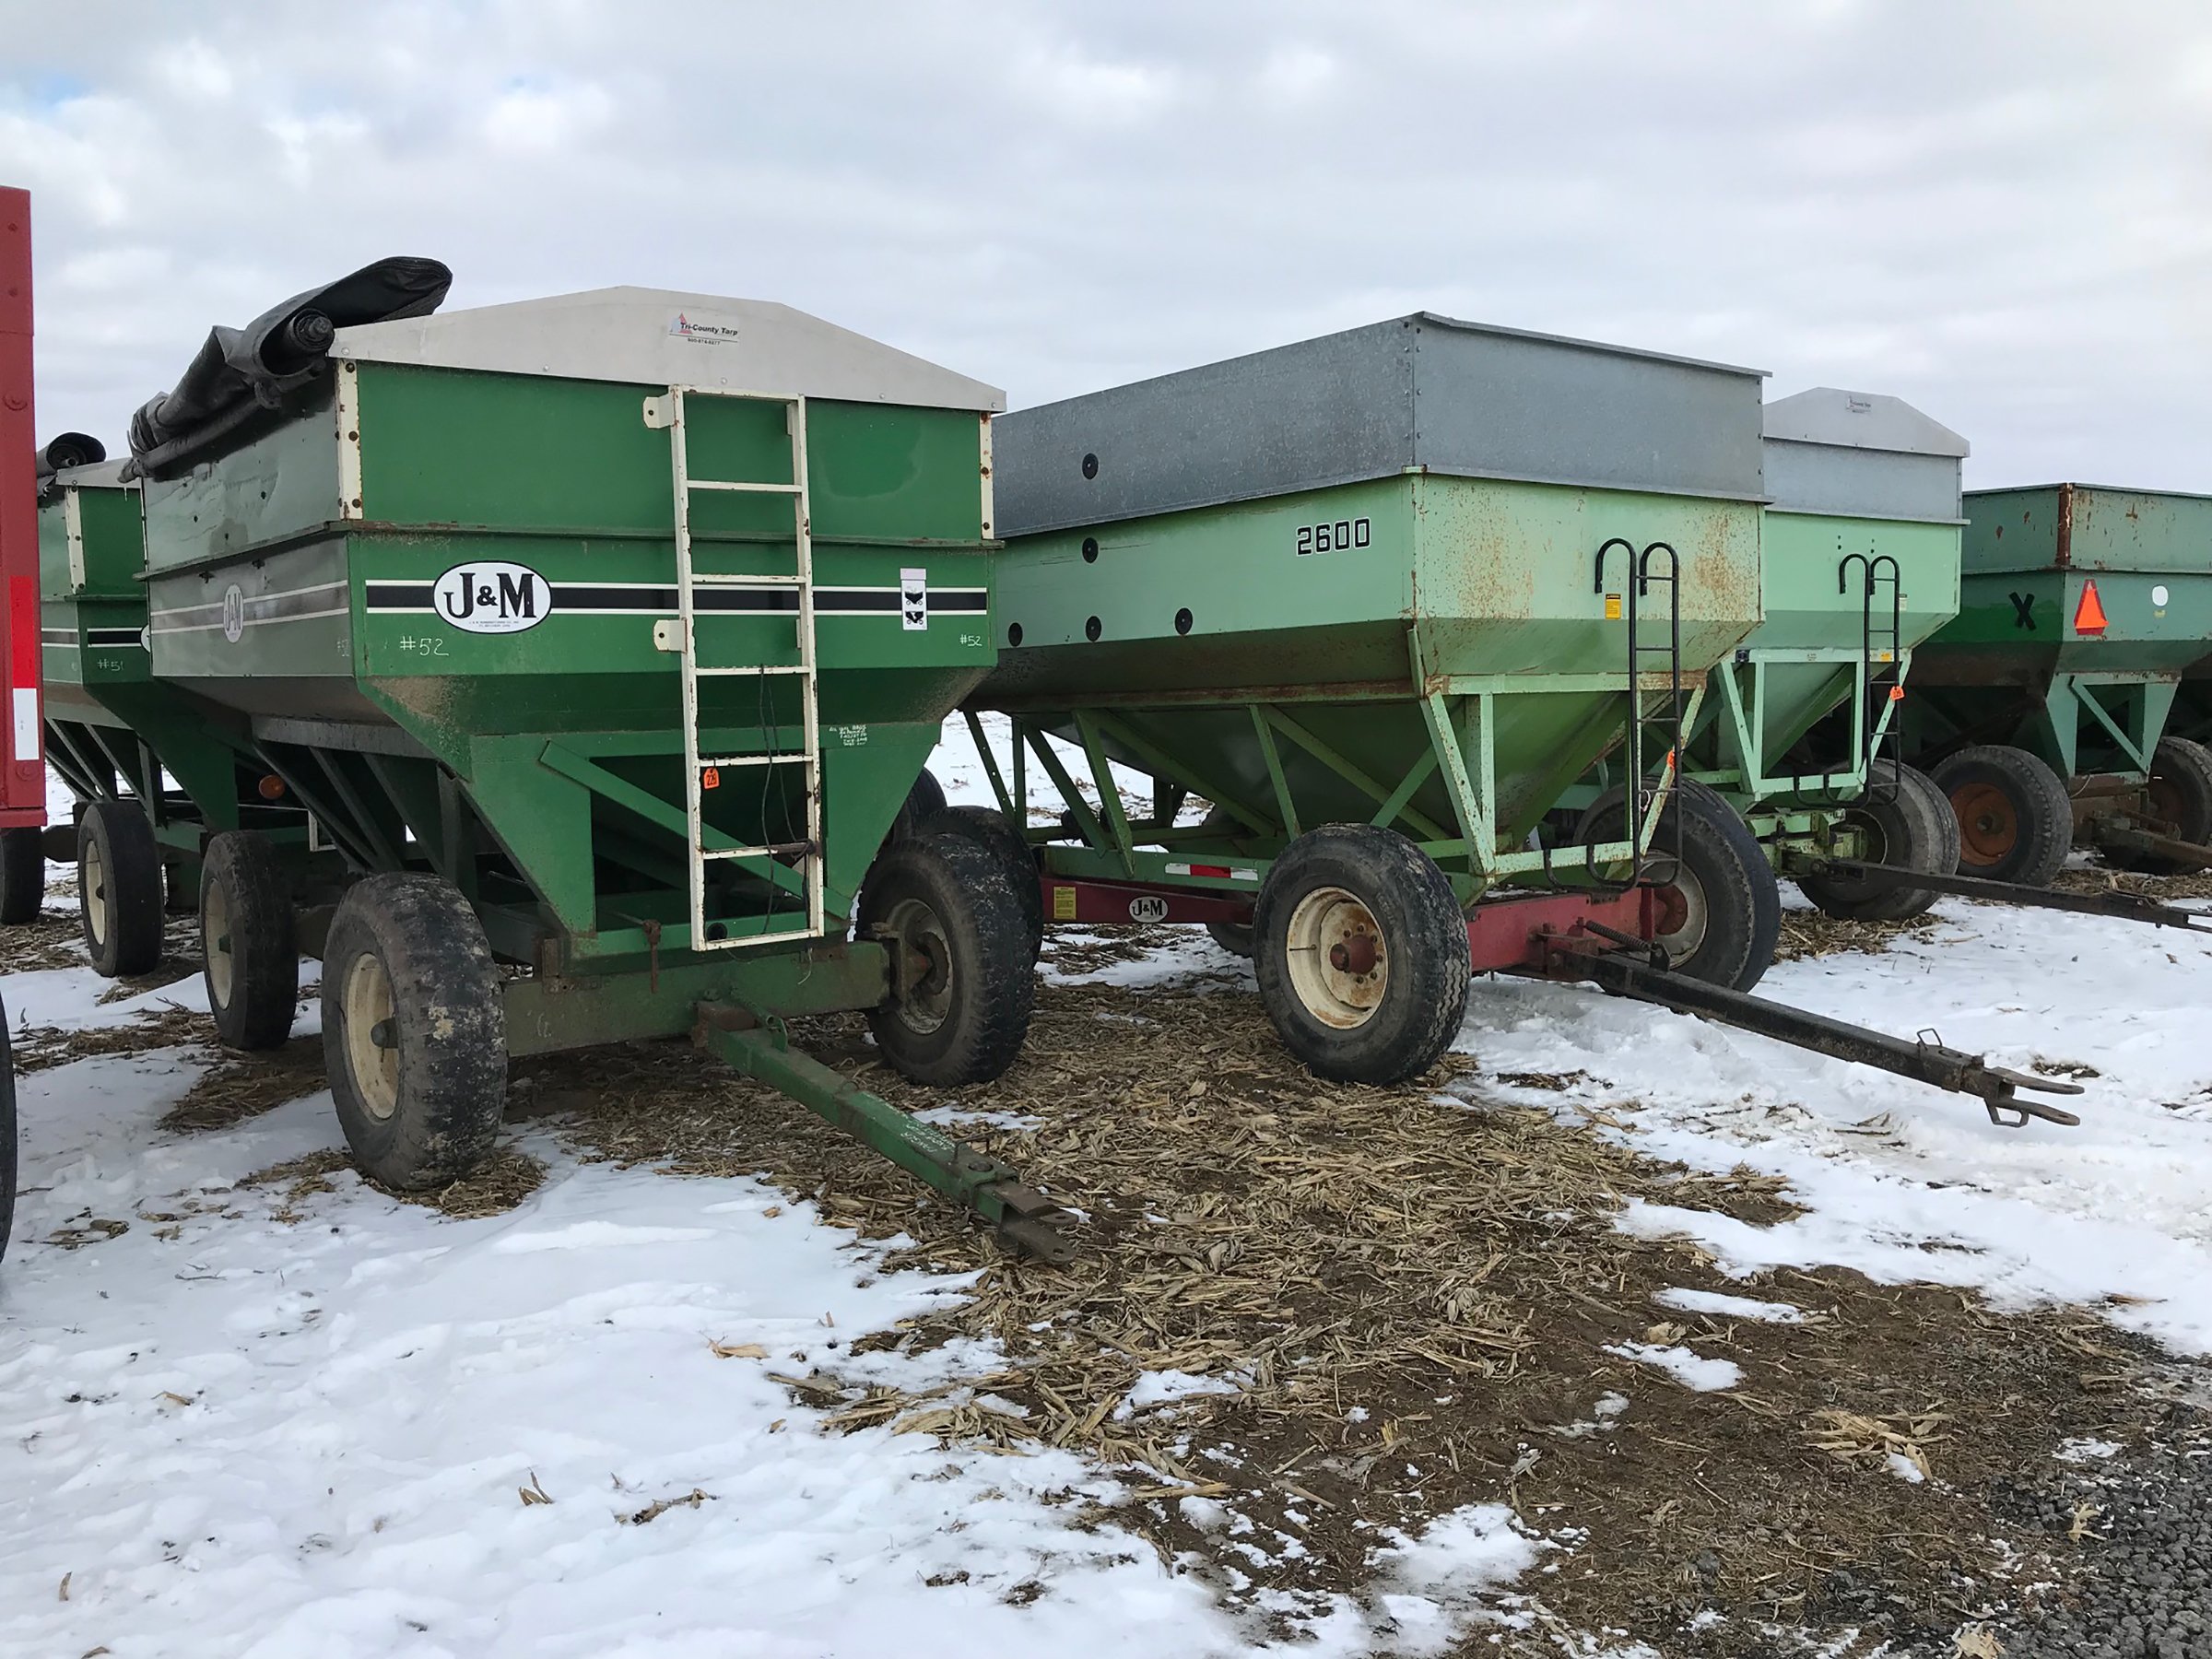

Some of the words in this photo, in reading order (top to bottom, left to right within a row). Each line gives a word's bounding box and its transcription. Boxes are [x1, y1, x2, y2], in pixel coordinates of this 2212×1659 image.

[680, 322, 719, 335] Tri-County
[721, 326, 738, 336] Tarp
[1296, 516, 1371, 557] 2600
[443, 572, 537, 618] J&M
[399, 636, 450, 656] #52
[959, 633, 983, 647] #52
[97, 658, 124, 672] #51
[1132, 900, 1164, 916] J&M
